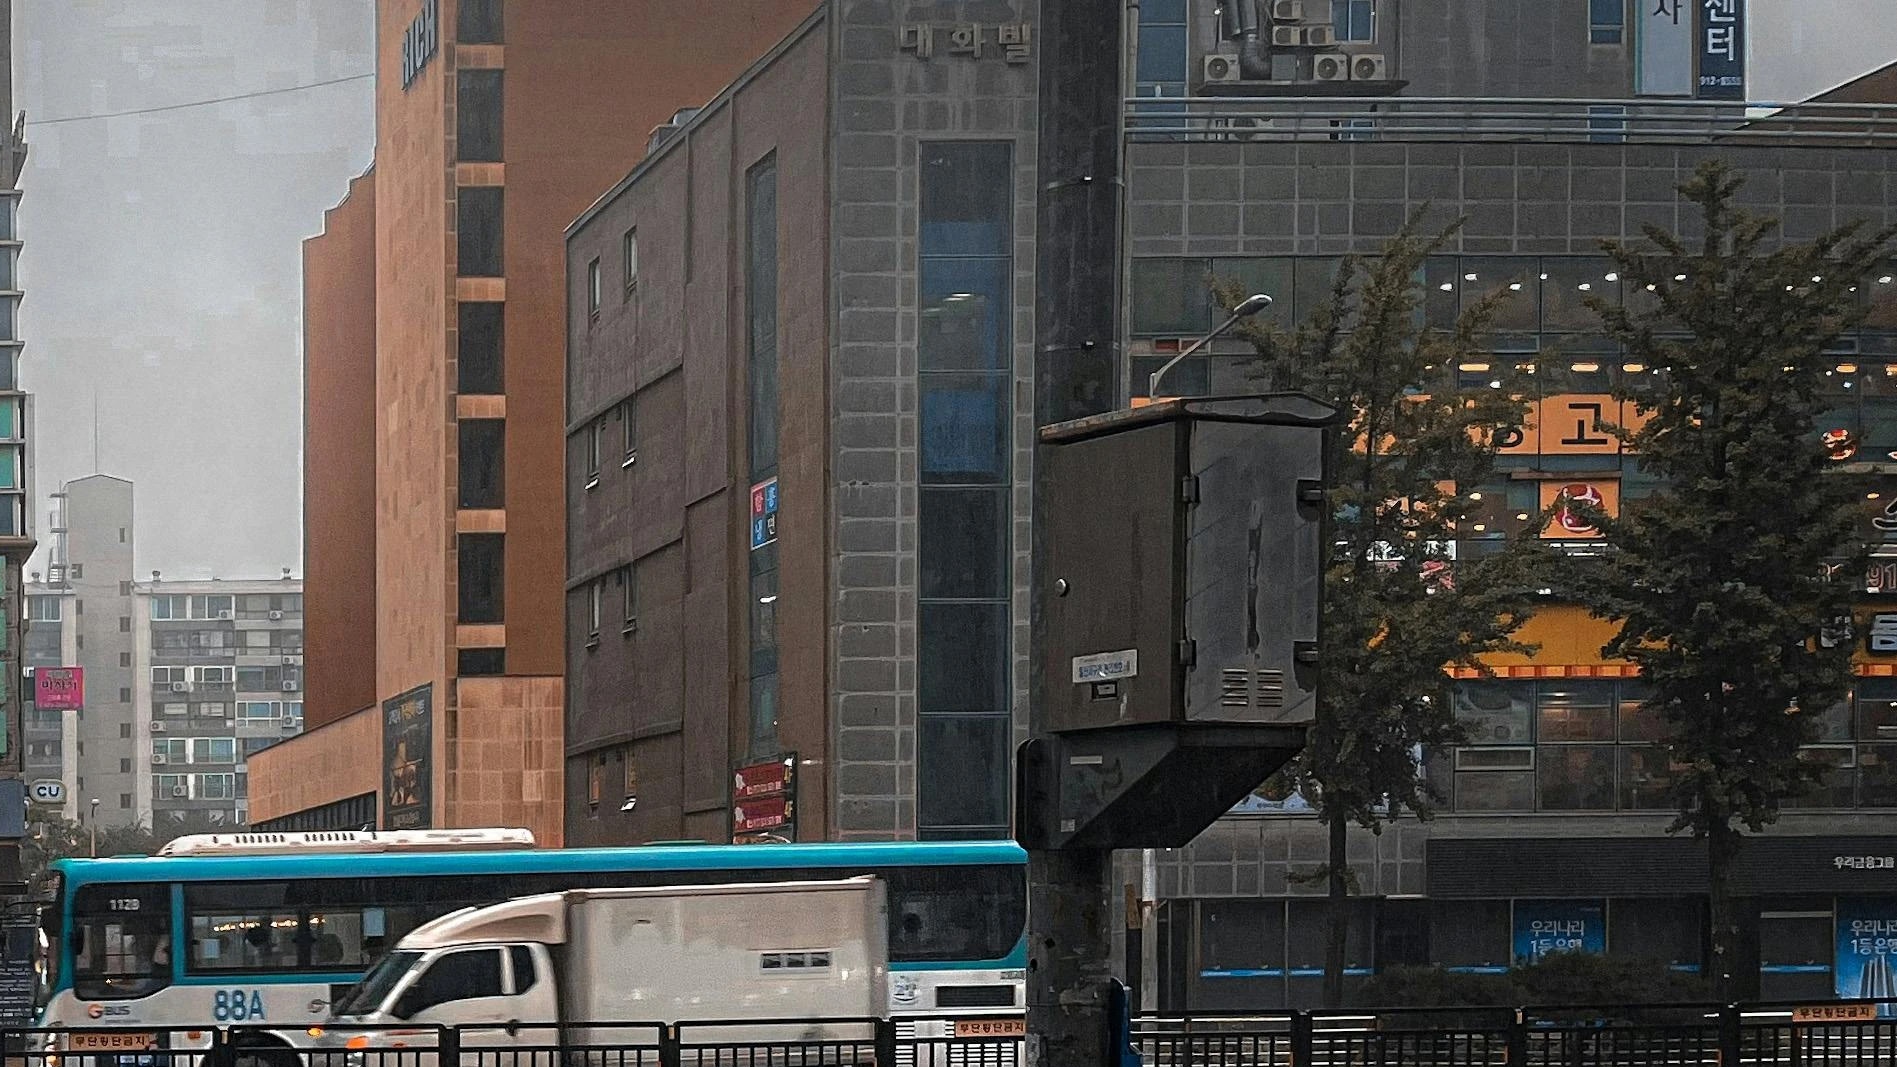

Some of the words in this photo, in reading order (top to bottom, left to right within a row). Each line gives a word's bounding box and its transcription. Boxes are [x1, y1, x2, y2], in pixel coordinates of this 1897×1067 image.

[37, 784, 60, 798] CU
[214, 989, 265, 1021] 88A
[74, 1033, 146, 1048] 무단횡단금지
